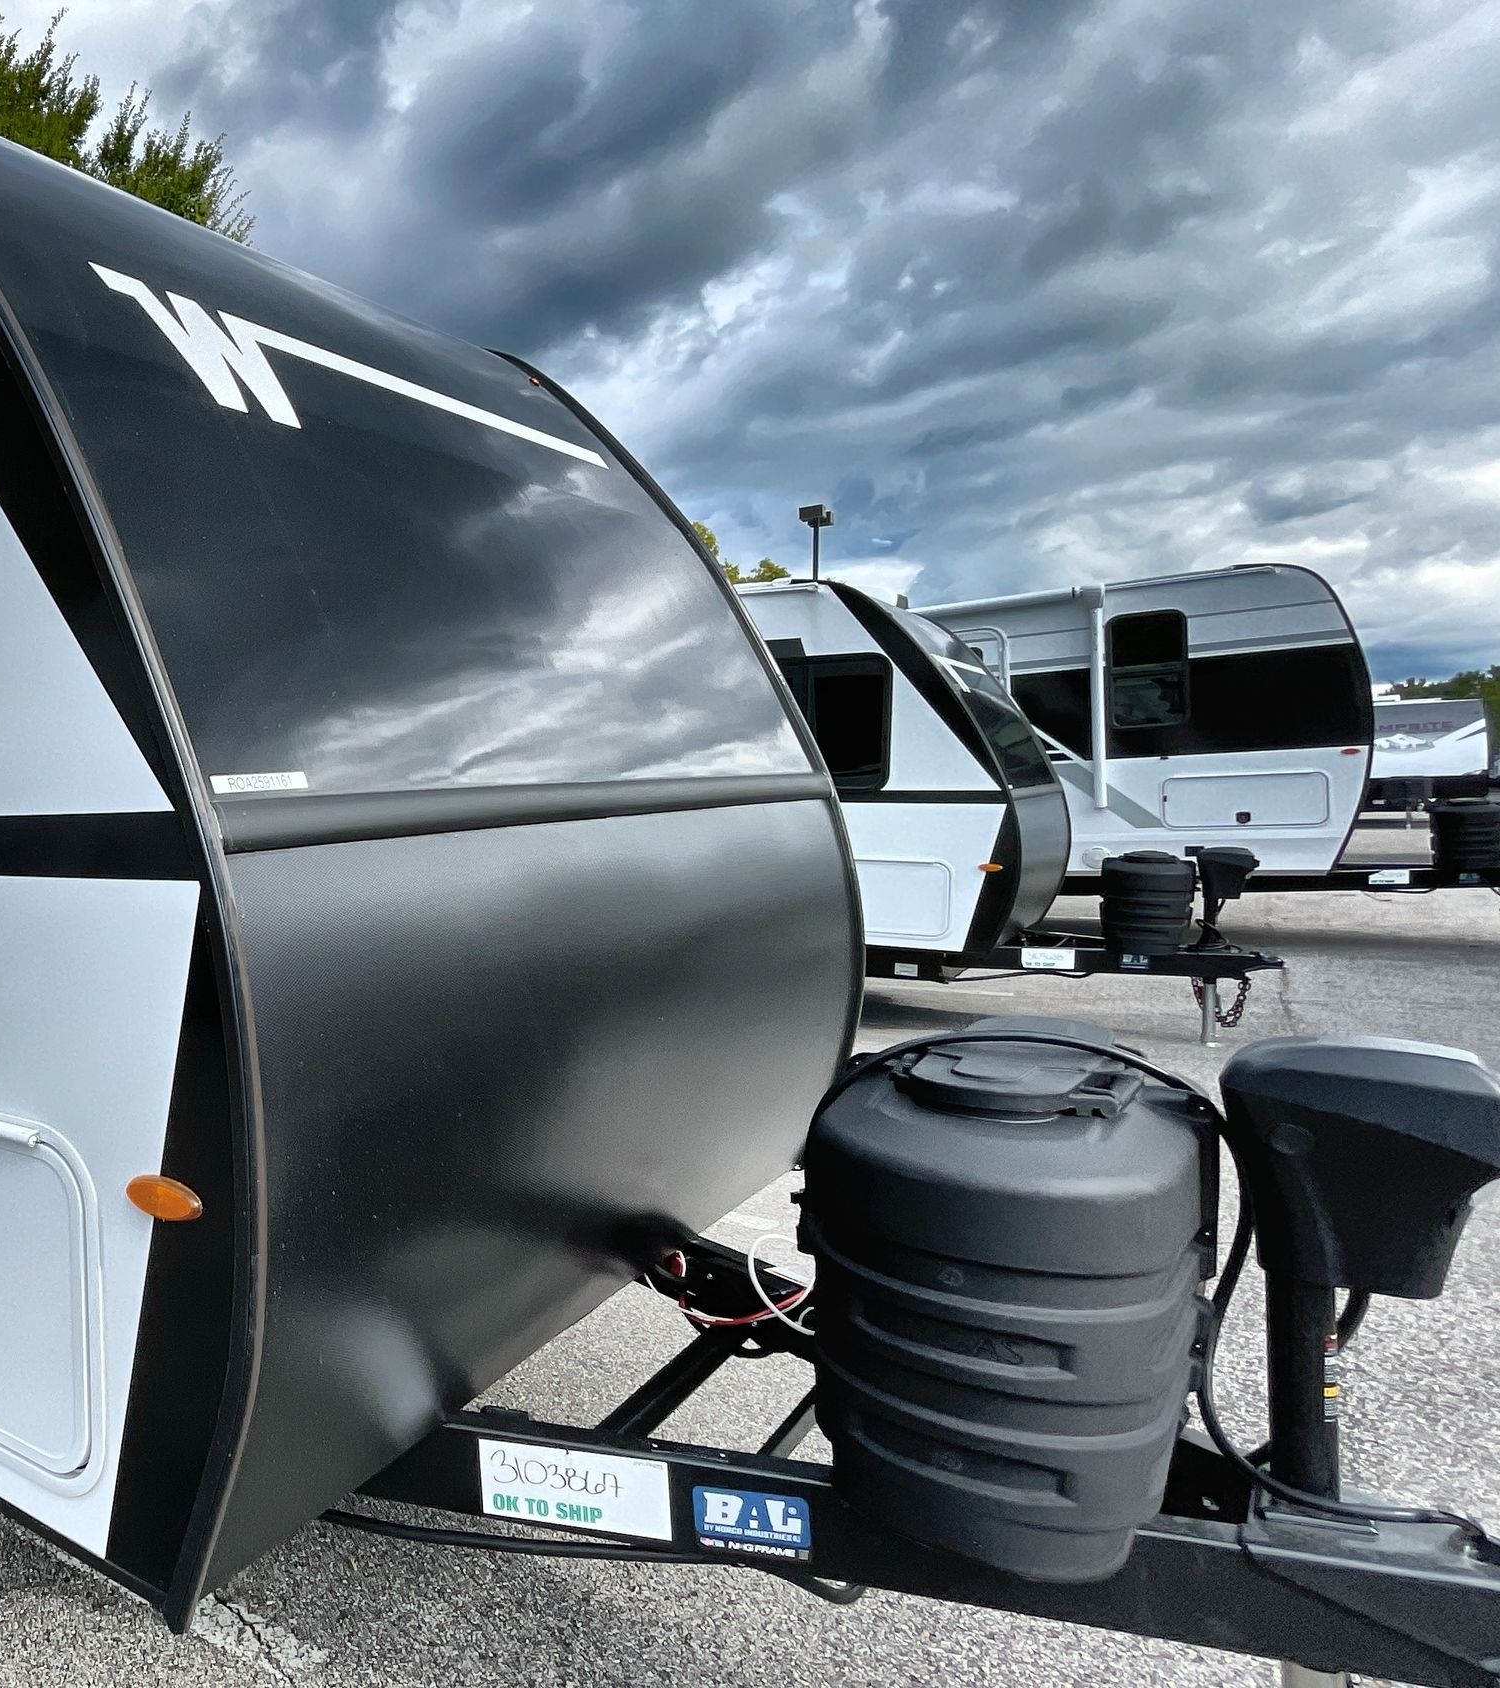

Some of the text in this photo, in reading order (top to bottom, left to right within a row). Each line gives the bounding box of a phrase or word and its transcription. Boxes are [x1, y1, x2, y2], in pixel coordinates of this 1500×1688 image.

[1379, 720, 1454, 733] MPSITE
[490, 1448, 625, 1499] 3103867
[493, 1493, 604, 1524] OK TO SHIP
[702, 1491, 803, 1535] BAL
[715, 1525, 743, 1535] NORCO
[743, 1529, 793, 1540] INDUSTRIES
